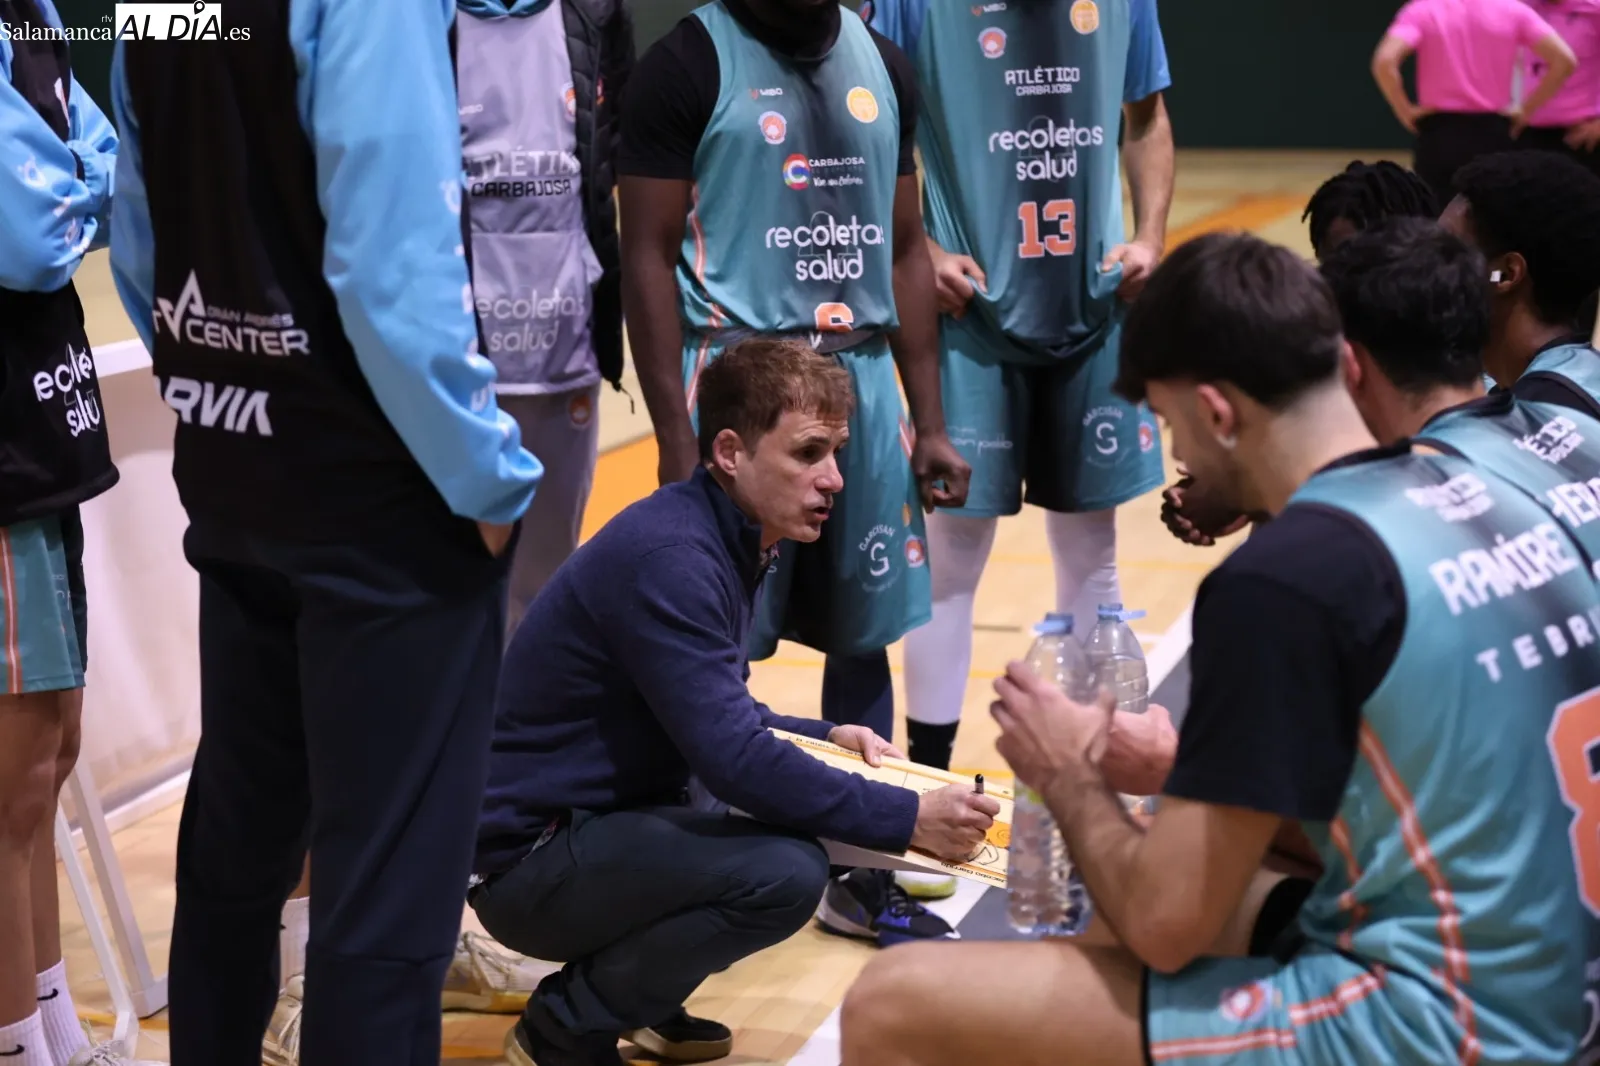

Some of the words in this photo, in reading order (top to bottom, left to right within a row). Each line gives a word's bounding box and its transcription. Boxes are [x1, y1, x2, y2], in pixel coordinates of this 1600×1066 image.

[1004, 65, 1081, 85] ATLÉTICO
[1016, 83, 1073, 96] CARBAJOSA
[988, 118, 1104, 153] recoletas
[808, 156, 866, 167] CARBAJOSA
[1016, 149, 1077, 181] salud
[471, 178, 571, 198] CARBAJOSA
[1018, 199, 1077, 259] 13
[795, 248, 864, 281] salud
[475, 287, 585, 320] ecoletas
[185, 318, 311, 357] CENTER
[490, 320, 560, 353] salud
[153, 375, 273, 437] RVIA
